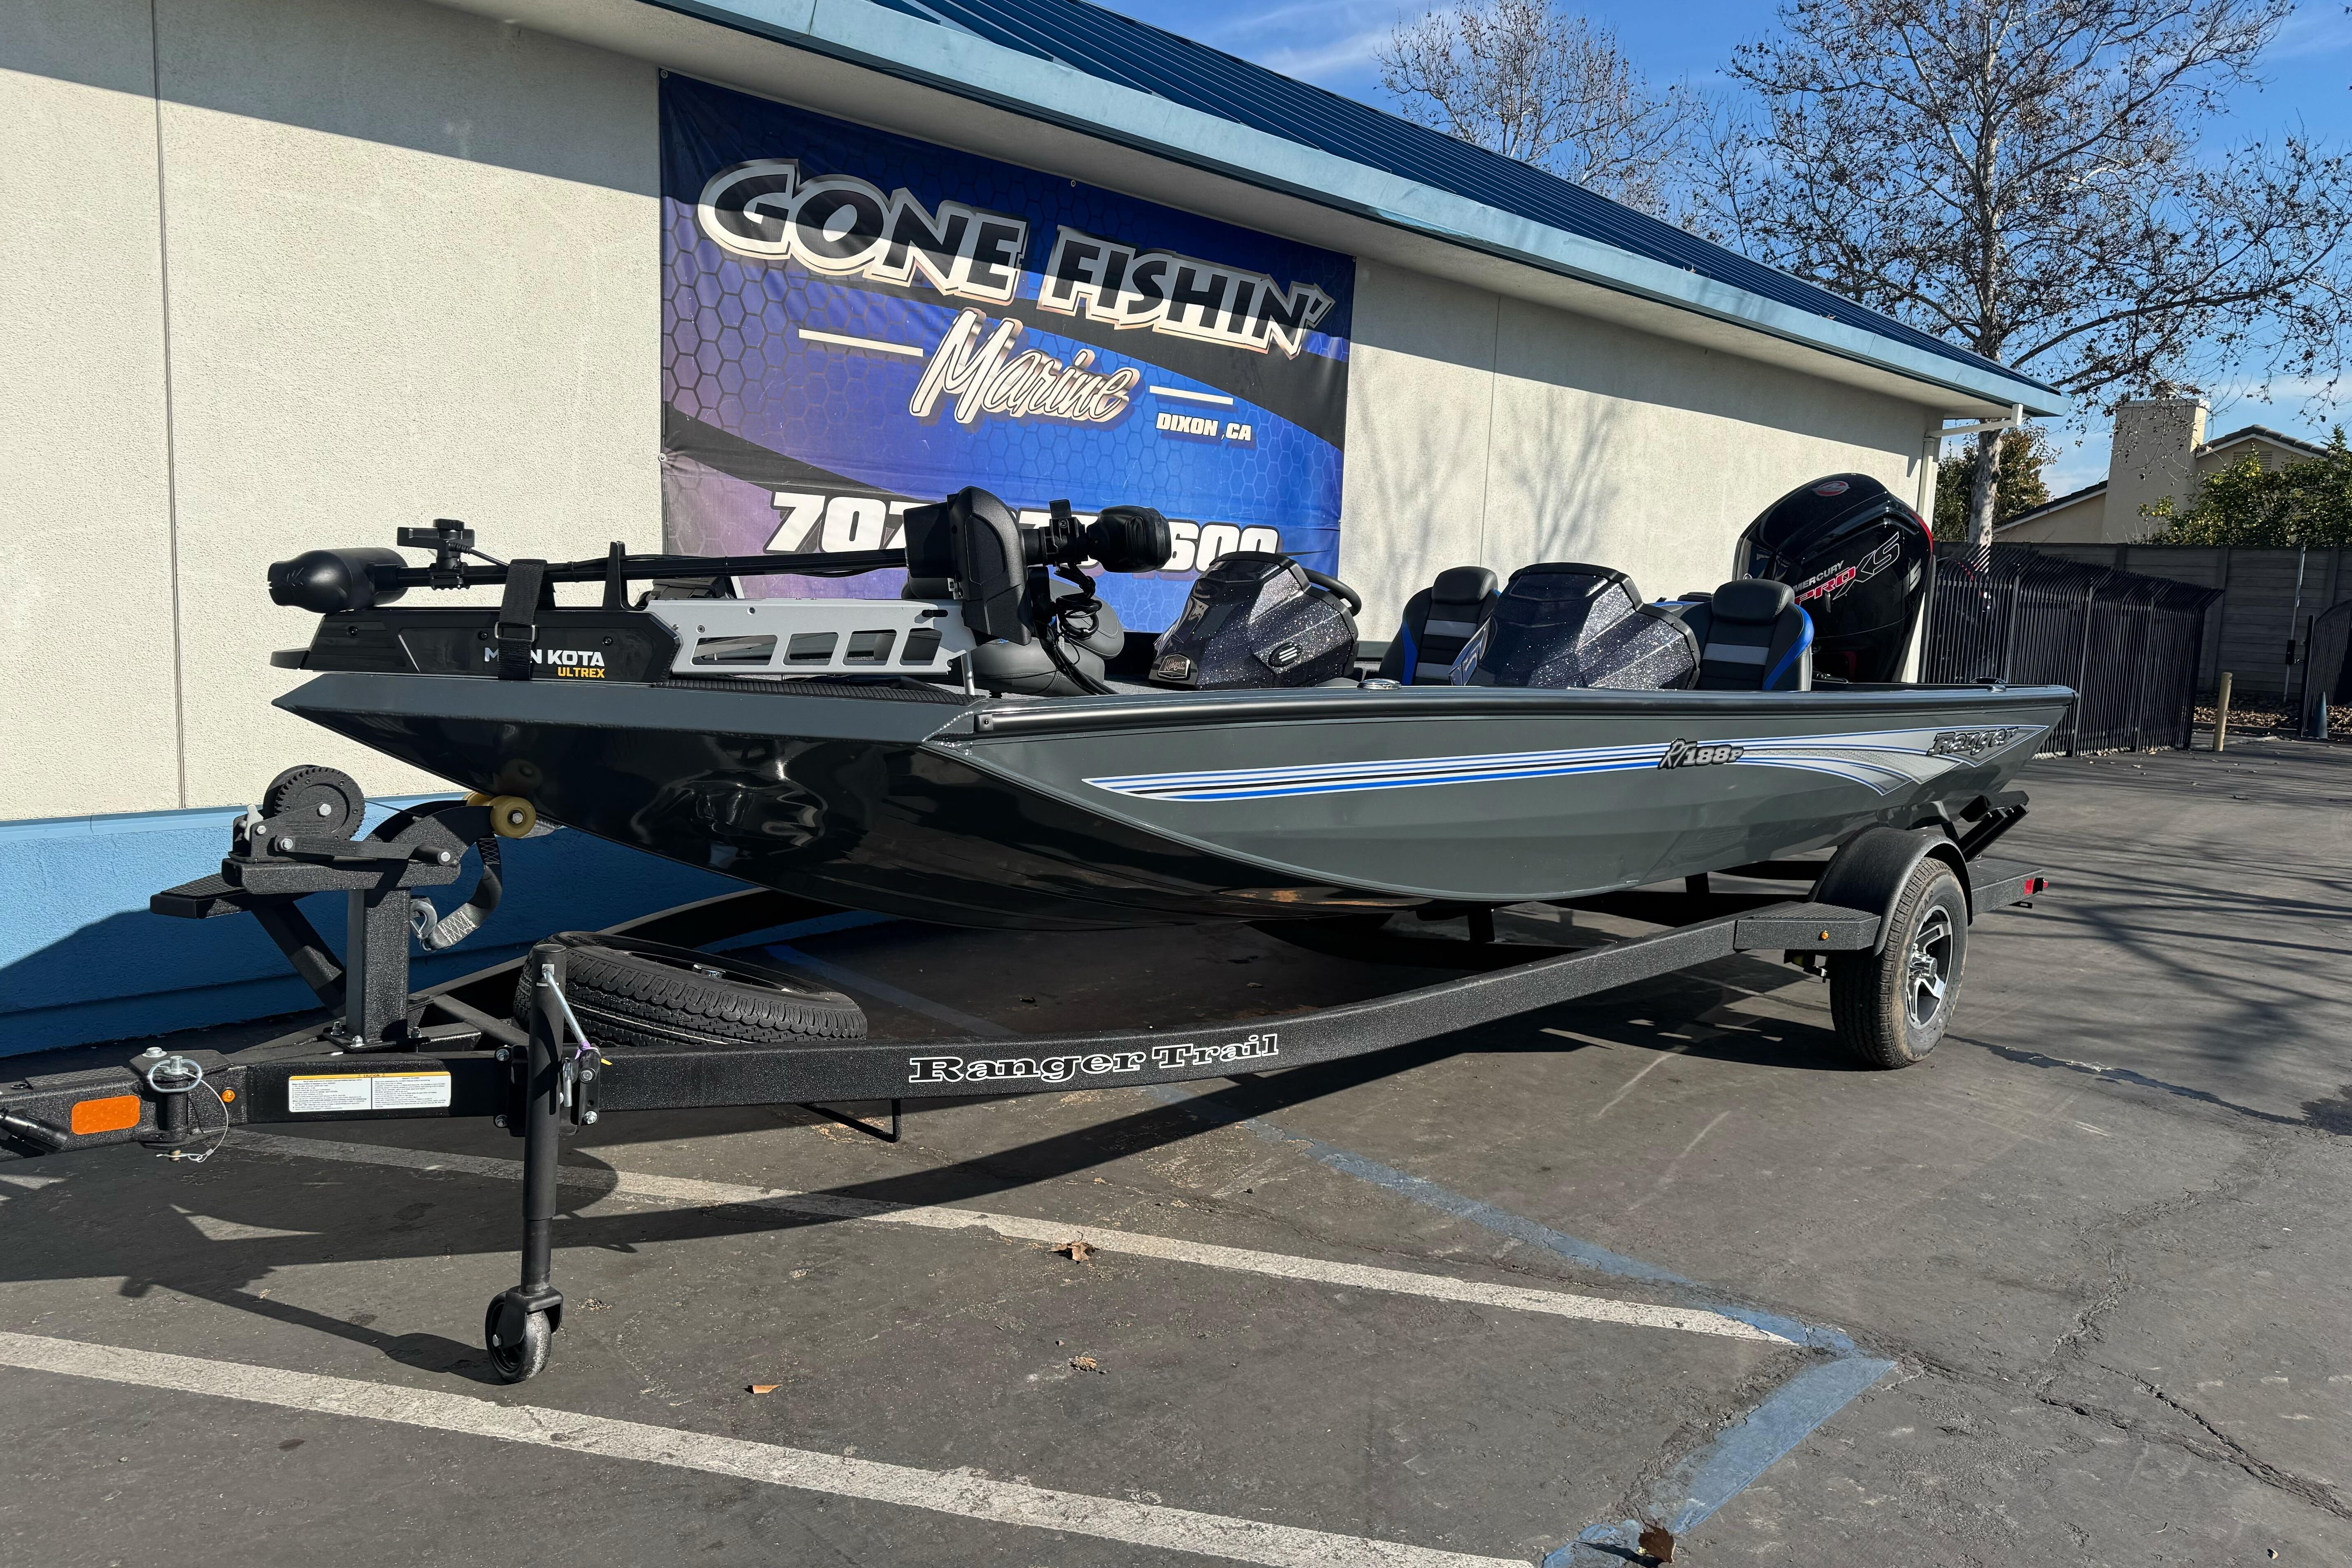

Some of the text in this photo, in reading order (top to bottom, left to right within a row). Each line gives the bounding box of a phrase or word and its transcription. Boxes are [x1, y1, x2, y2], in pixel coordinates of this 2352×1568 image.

[699, 161, 1333, 357] GONE FISHIN'
[909, 307, 1139, 423] Marine
[1156, 412, 1219, 436] DIXON
[1792, 560, 1844, 592] MERCURY
[484, 647, 605, 667] MN KOTA
[558, 667, 605, 678] ULTREX
[909, 1033, 1279, 1083] Ranger Trail
